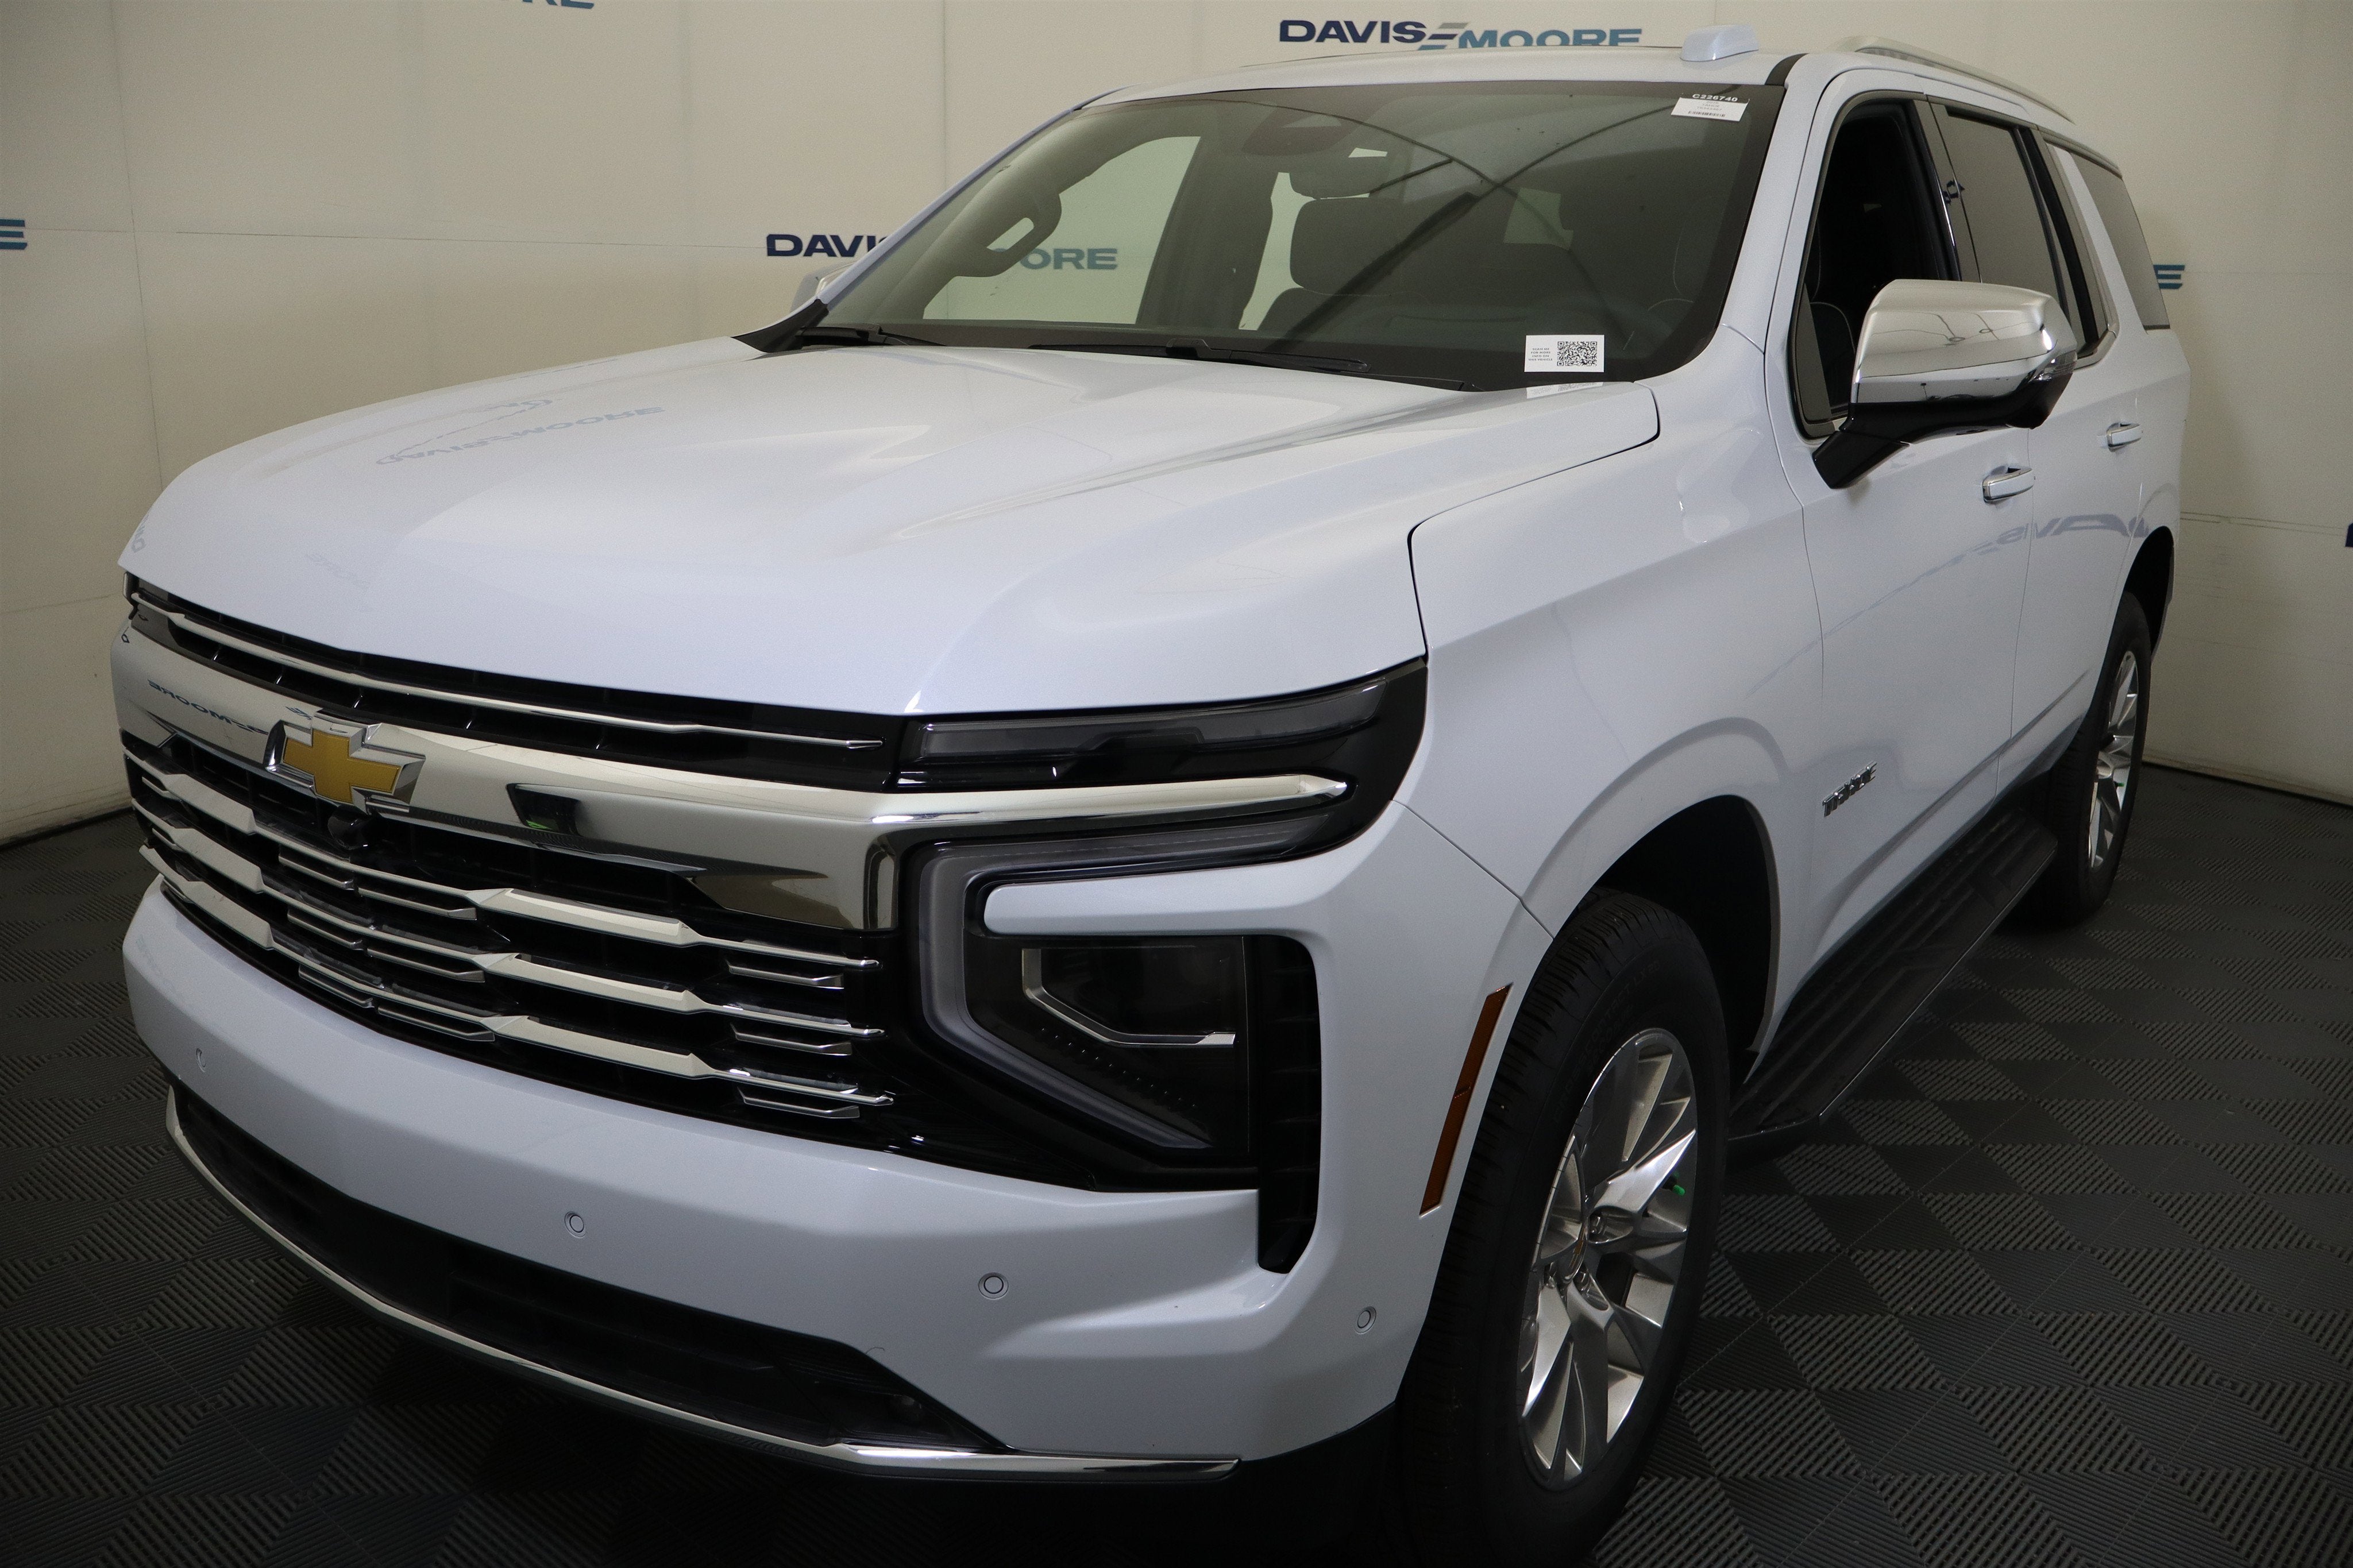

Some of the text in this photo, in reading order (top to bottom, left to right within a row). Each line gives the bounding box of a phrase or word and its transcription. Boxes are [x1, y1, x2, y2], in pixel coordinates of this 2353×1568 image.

[1279, 20, 1643, 49] DAVIS MOORE
[1692, 94, 1738, 102] C226740
[766, 234, 1118, 270] DAVI ORE
